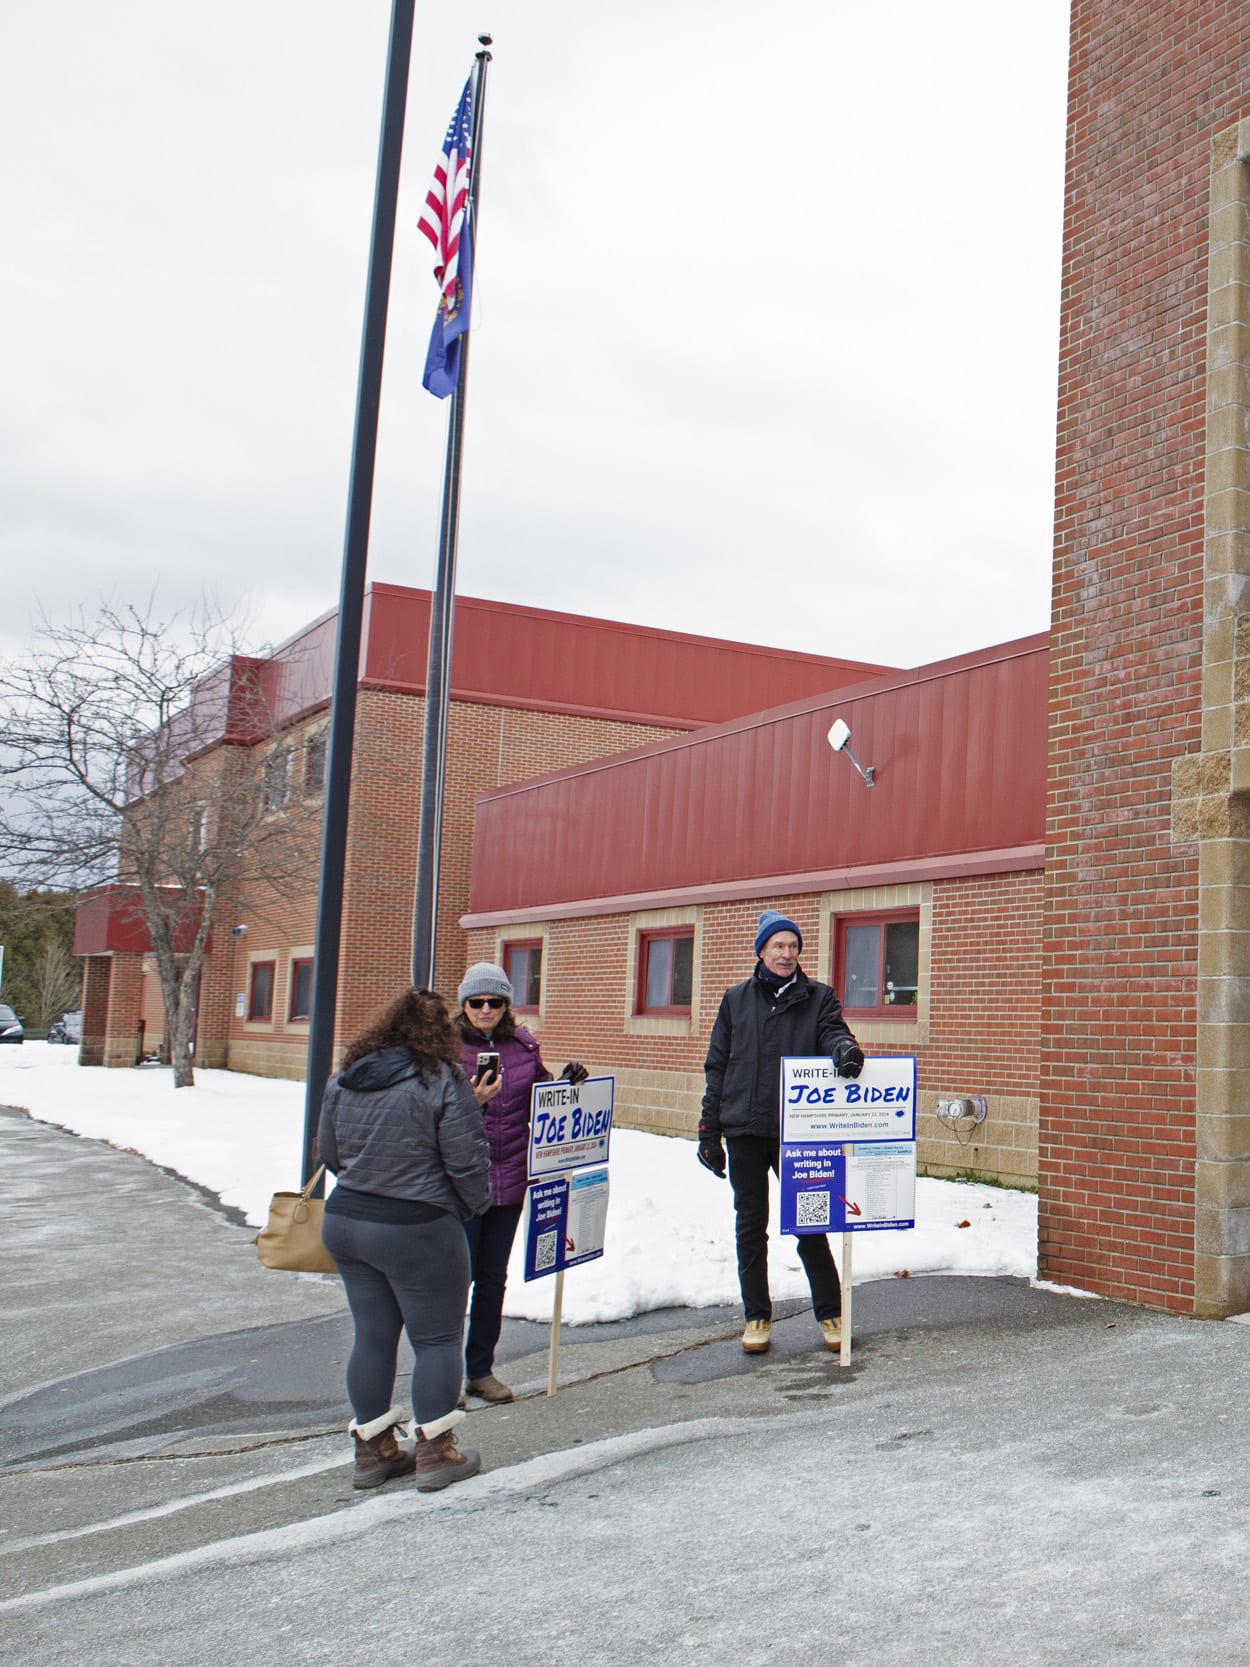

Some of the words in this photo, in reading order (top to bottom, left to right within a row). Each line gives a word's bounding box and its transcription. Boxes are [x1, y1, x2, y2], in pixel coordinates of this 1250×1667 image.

[538, 1087, 580, 1108] WRITE-IN
[788, 1084, 837, 1104] JOE
[844, 1083, 911, 1103] BIDEN
[534, 1112, 567, 1144] JOE
[571, 1107, 611, 1139] BIDEN
[810, 1121, 889, 1130] www.WriteInBiden.com
[786, 1149, 802, 1157] Ask
[818, 1148, 841, 1156] about
[793, 1159, 822, 1169] writing
[823, 1159, 832, 1167] in
[792, 1171, 808, 1179] Joe
[809, 1170, 835, 1178] Biden!
